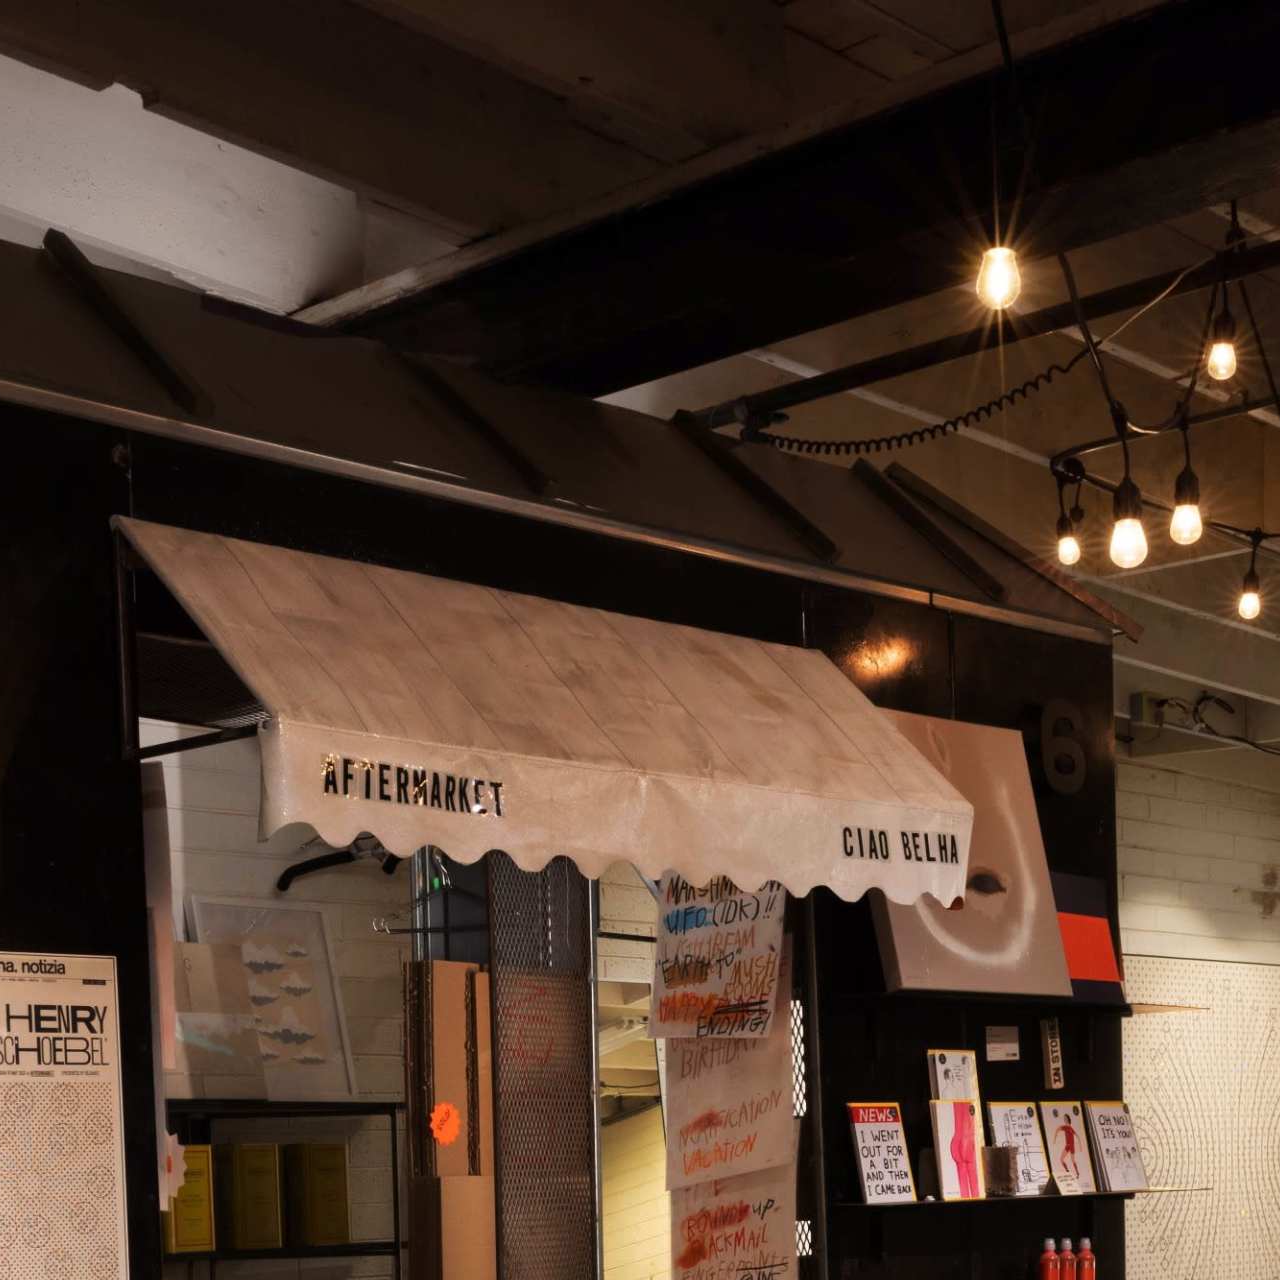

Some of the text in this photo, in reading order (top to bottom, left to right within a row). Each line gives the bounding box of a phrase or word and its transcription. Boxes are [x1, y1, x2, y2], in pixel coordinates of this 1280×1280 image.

[321, 756, 503, 816] AFTERMARKET
[842, 826, 960, 864] CIAO BELHA
[21, 959, 66, 975] notizia
[5, 1003, 108, 1034] HENRY
[859, 1108, 894, 1122] NEWS
[871, 1130, 899, 1142] WENT
[861, 1145, 903, 1158] OUT FOR
[869, 1158, 899, 1169] A BIT
[866, 1170, 908, 1181] AND THEN
[875, 1184, 896, 1195] CAME
